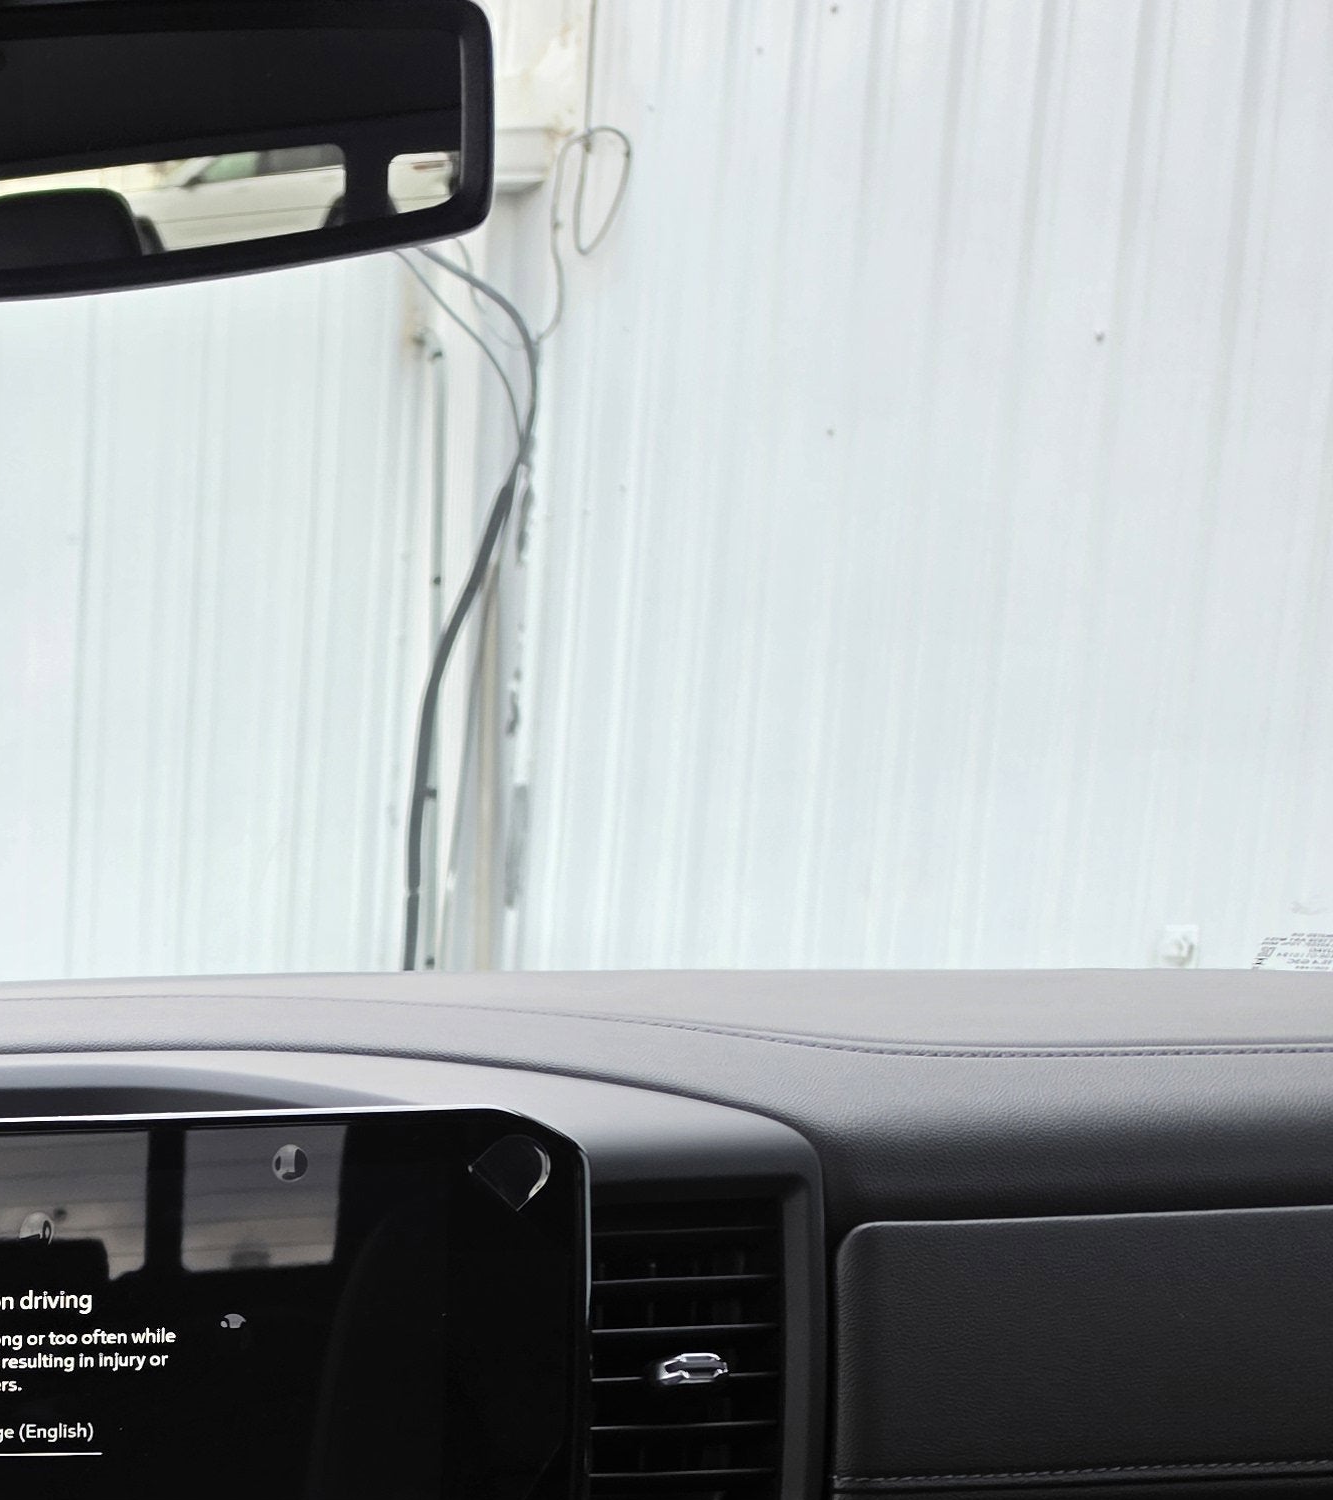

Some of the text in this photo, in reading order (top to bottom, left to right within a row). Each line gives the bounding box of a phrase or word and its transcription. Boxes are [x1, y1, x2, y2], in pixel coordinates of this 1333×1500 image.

[20, 1288, 93, 1314] driving
[27, 1335, 45, 1346] or
[48, 1331, 77, 1345] too
[81, 1328, 127, 1345] often
[132, 1327, 176, 1343] while
[2, 1352, 75, 1372] resulting
[79, 1353, 94, 1368] in
[99, 1351, 145, 1371] injury
[150, 1353, 168, 1367] or
[19, 1422, 94, 1443] (English)
